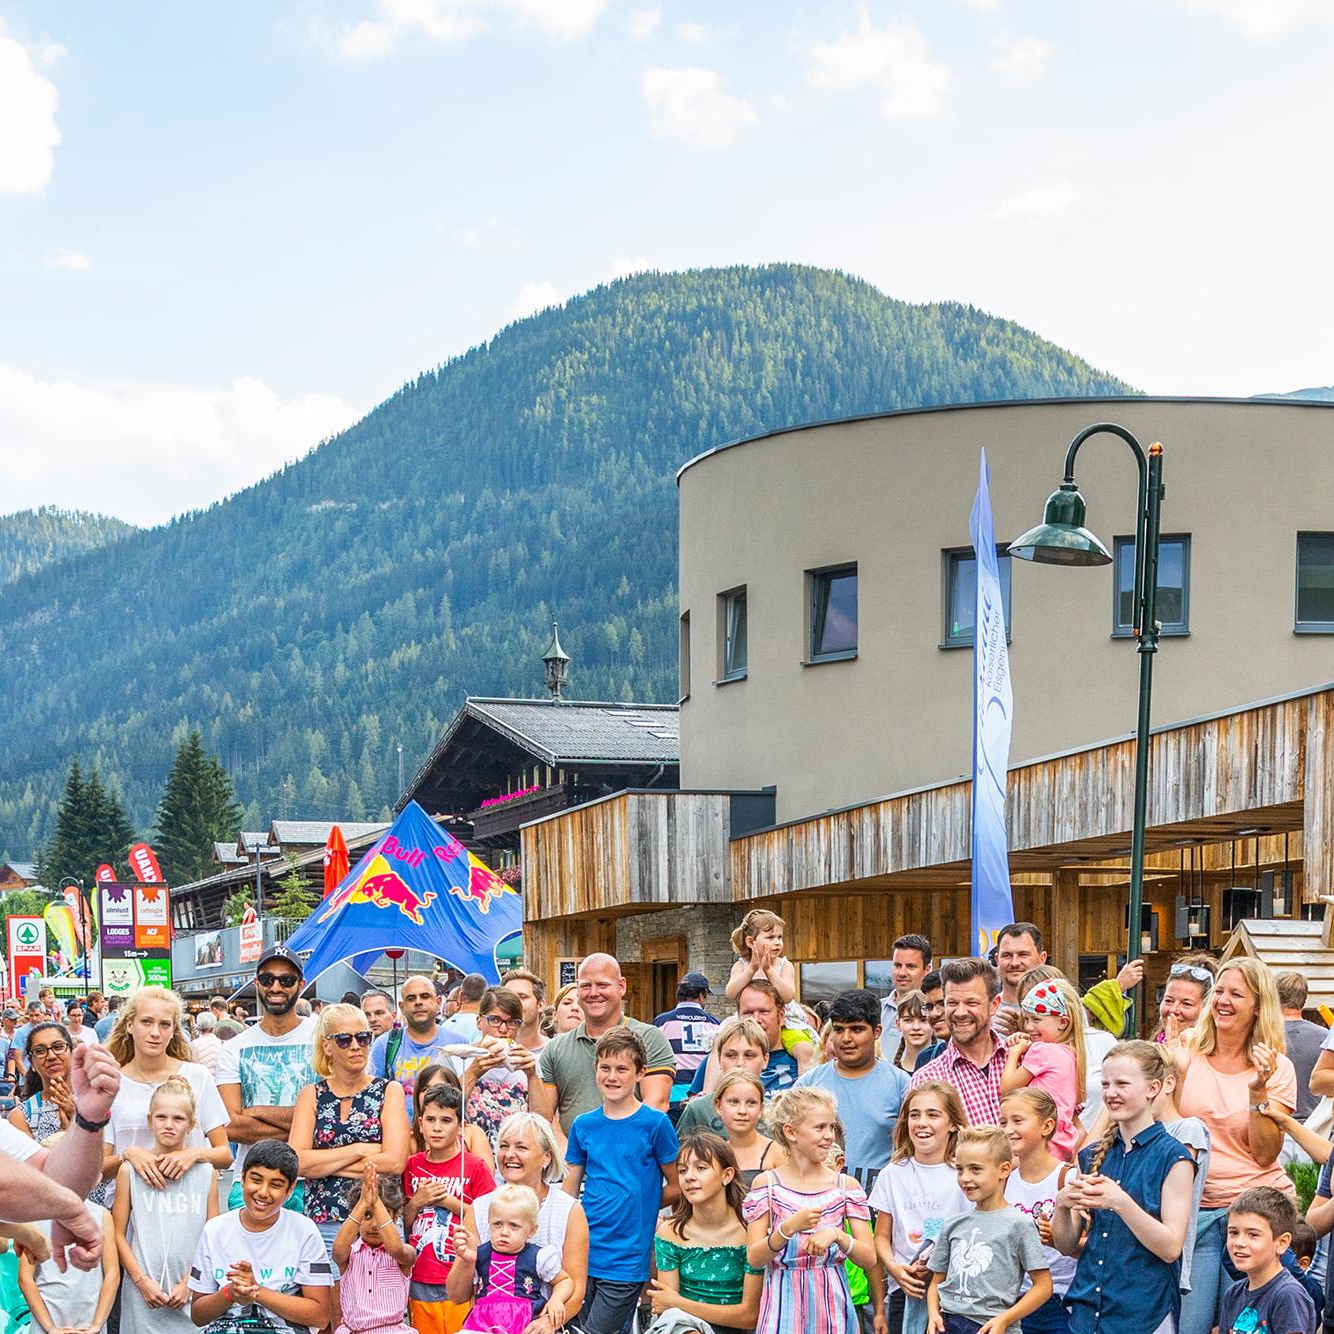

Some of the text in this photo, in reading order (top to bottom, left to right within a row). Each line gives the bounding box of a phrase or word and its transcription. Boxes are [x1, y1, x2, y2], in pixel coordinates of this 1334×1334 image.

[380, 836, 425, 869] Bull
[107, 928, 130, 936] LODGES
[683, 1024, 696, 1044] 1
[214, 1266, 295, 1280] DWN
